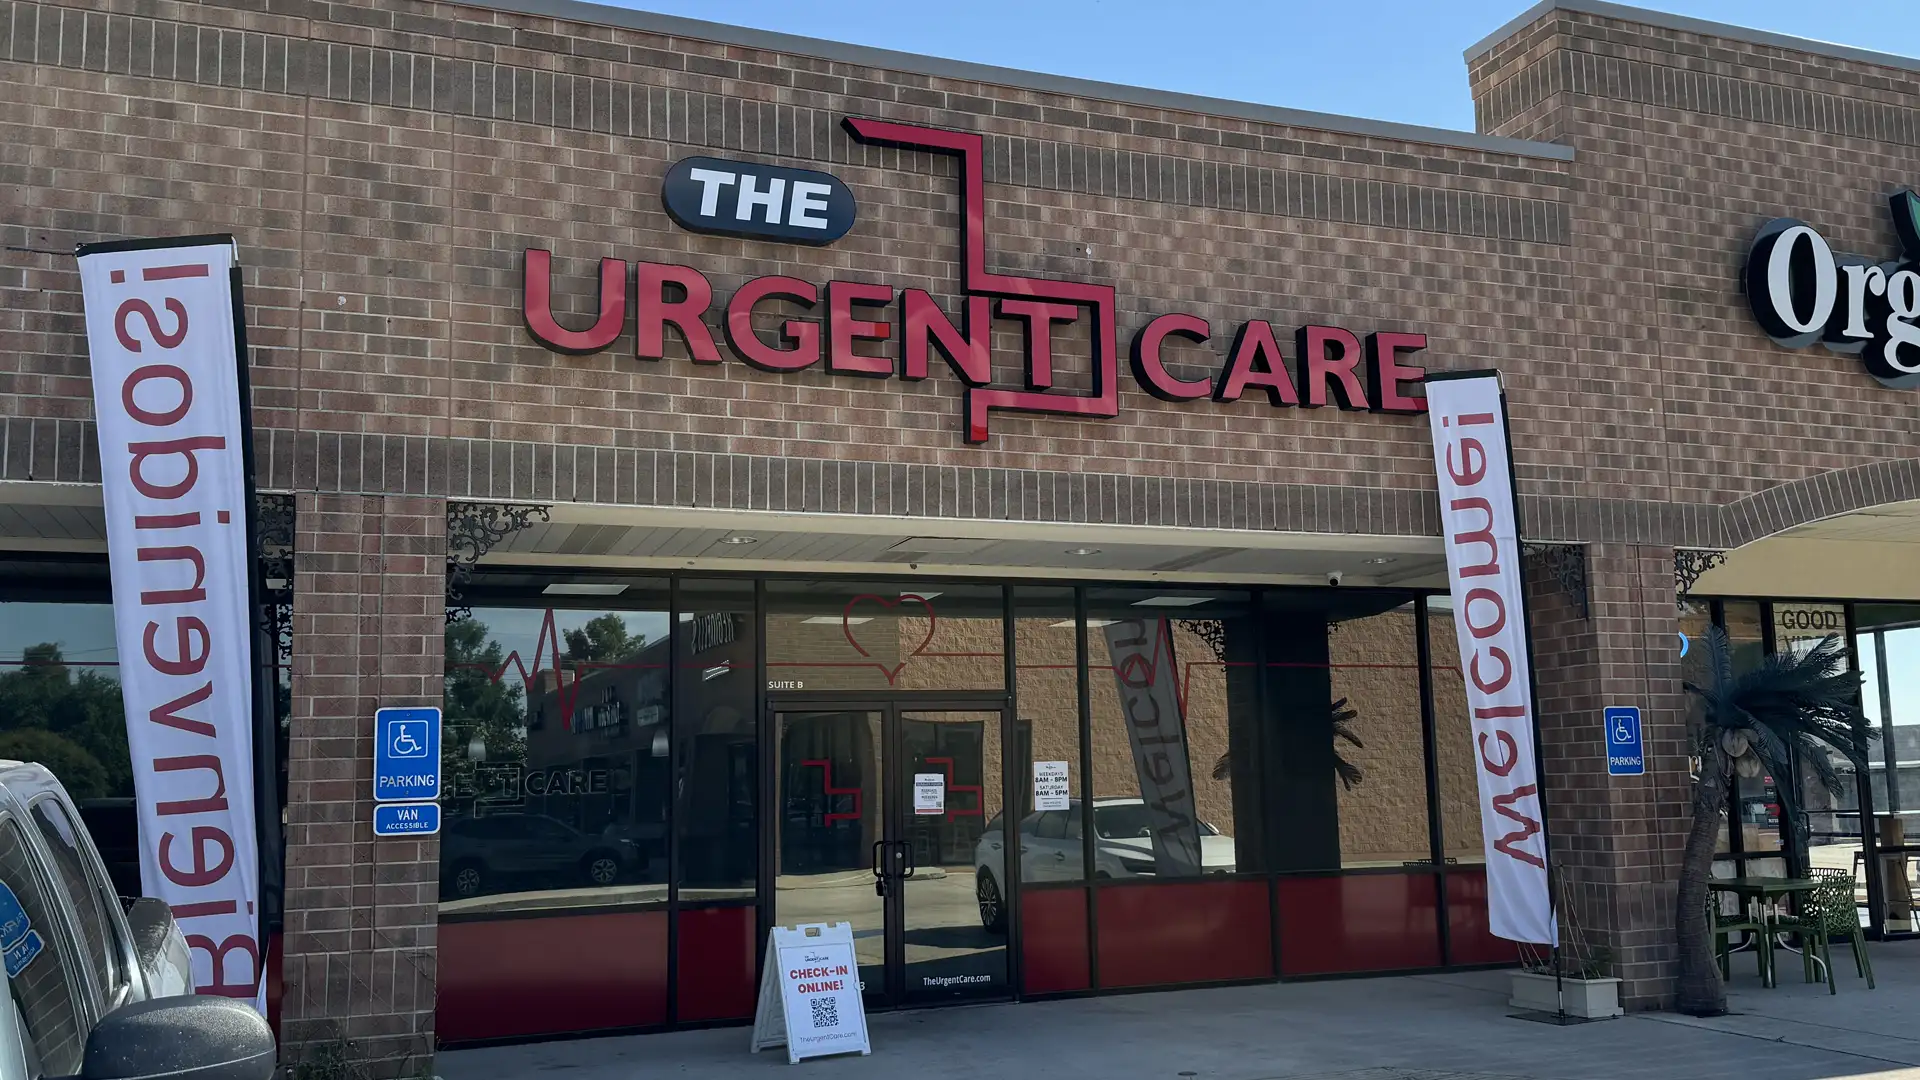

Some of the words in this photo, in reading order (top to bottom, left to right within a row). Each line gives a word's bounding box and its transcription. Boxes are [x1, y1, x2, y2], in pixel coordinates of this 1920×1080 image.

[690, 167, 831, 229] THE
[523, 248, 1078, 390] URGENT
[1130, 311, 1427, 414] CARE
[1782, 609, 1837, 629] GOOD
[768, 680, 795, 689] SUITE
[797, 680, 804, 688] B
[1610, 756, 1642, 766] PARKING
[380, 774, 435, 788] PARKING
[397, 809, 418, 820] VAN
[386, 822, 428, 830] ACCESSIBLE
[790, 965, 848, 980] CHECK-IN
[798, 980, 844, 994] ONLINE!
[923, 975, 990, 986] TheUrgentCare.com
